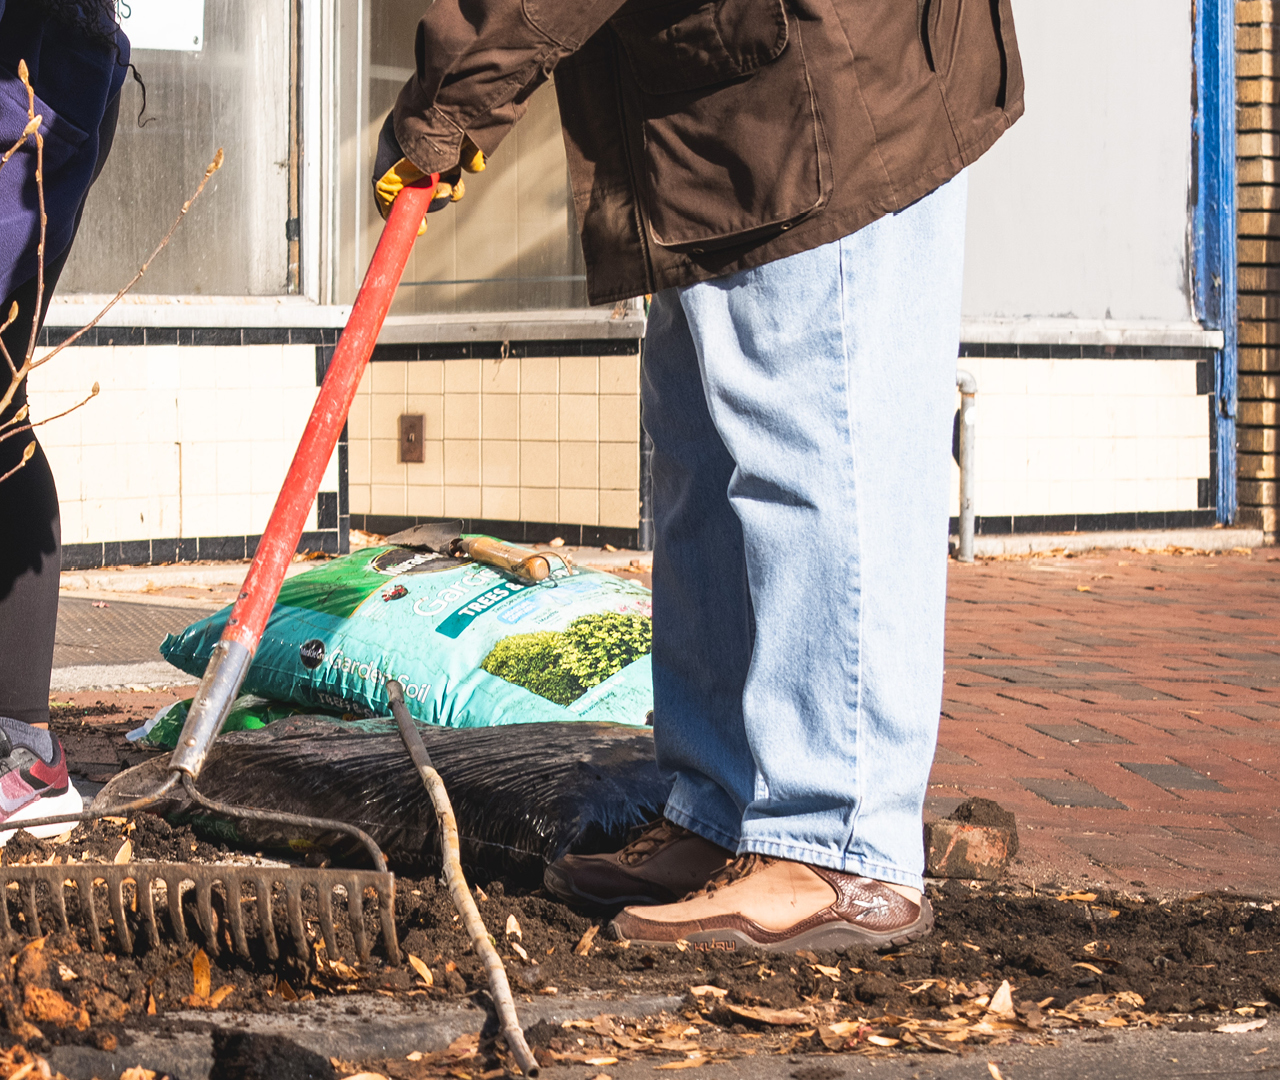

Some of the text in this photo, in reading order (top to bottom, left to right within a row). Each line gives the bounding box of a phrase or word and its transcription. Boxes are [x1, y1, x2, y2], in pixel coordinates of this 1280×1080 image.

[412, 565, 502, 617] Garde
[458, 586, 510, 618] TREES
[397, 674, 432, 704] Soil
